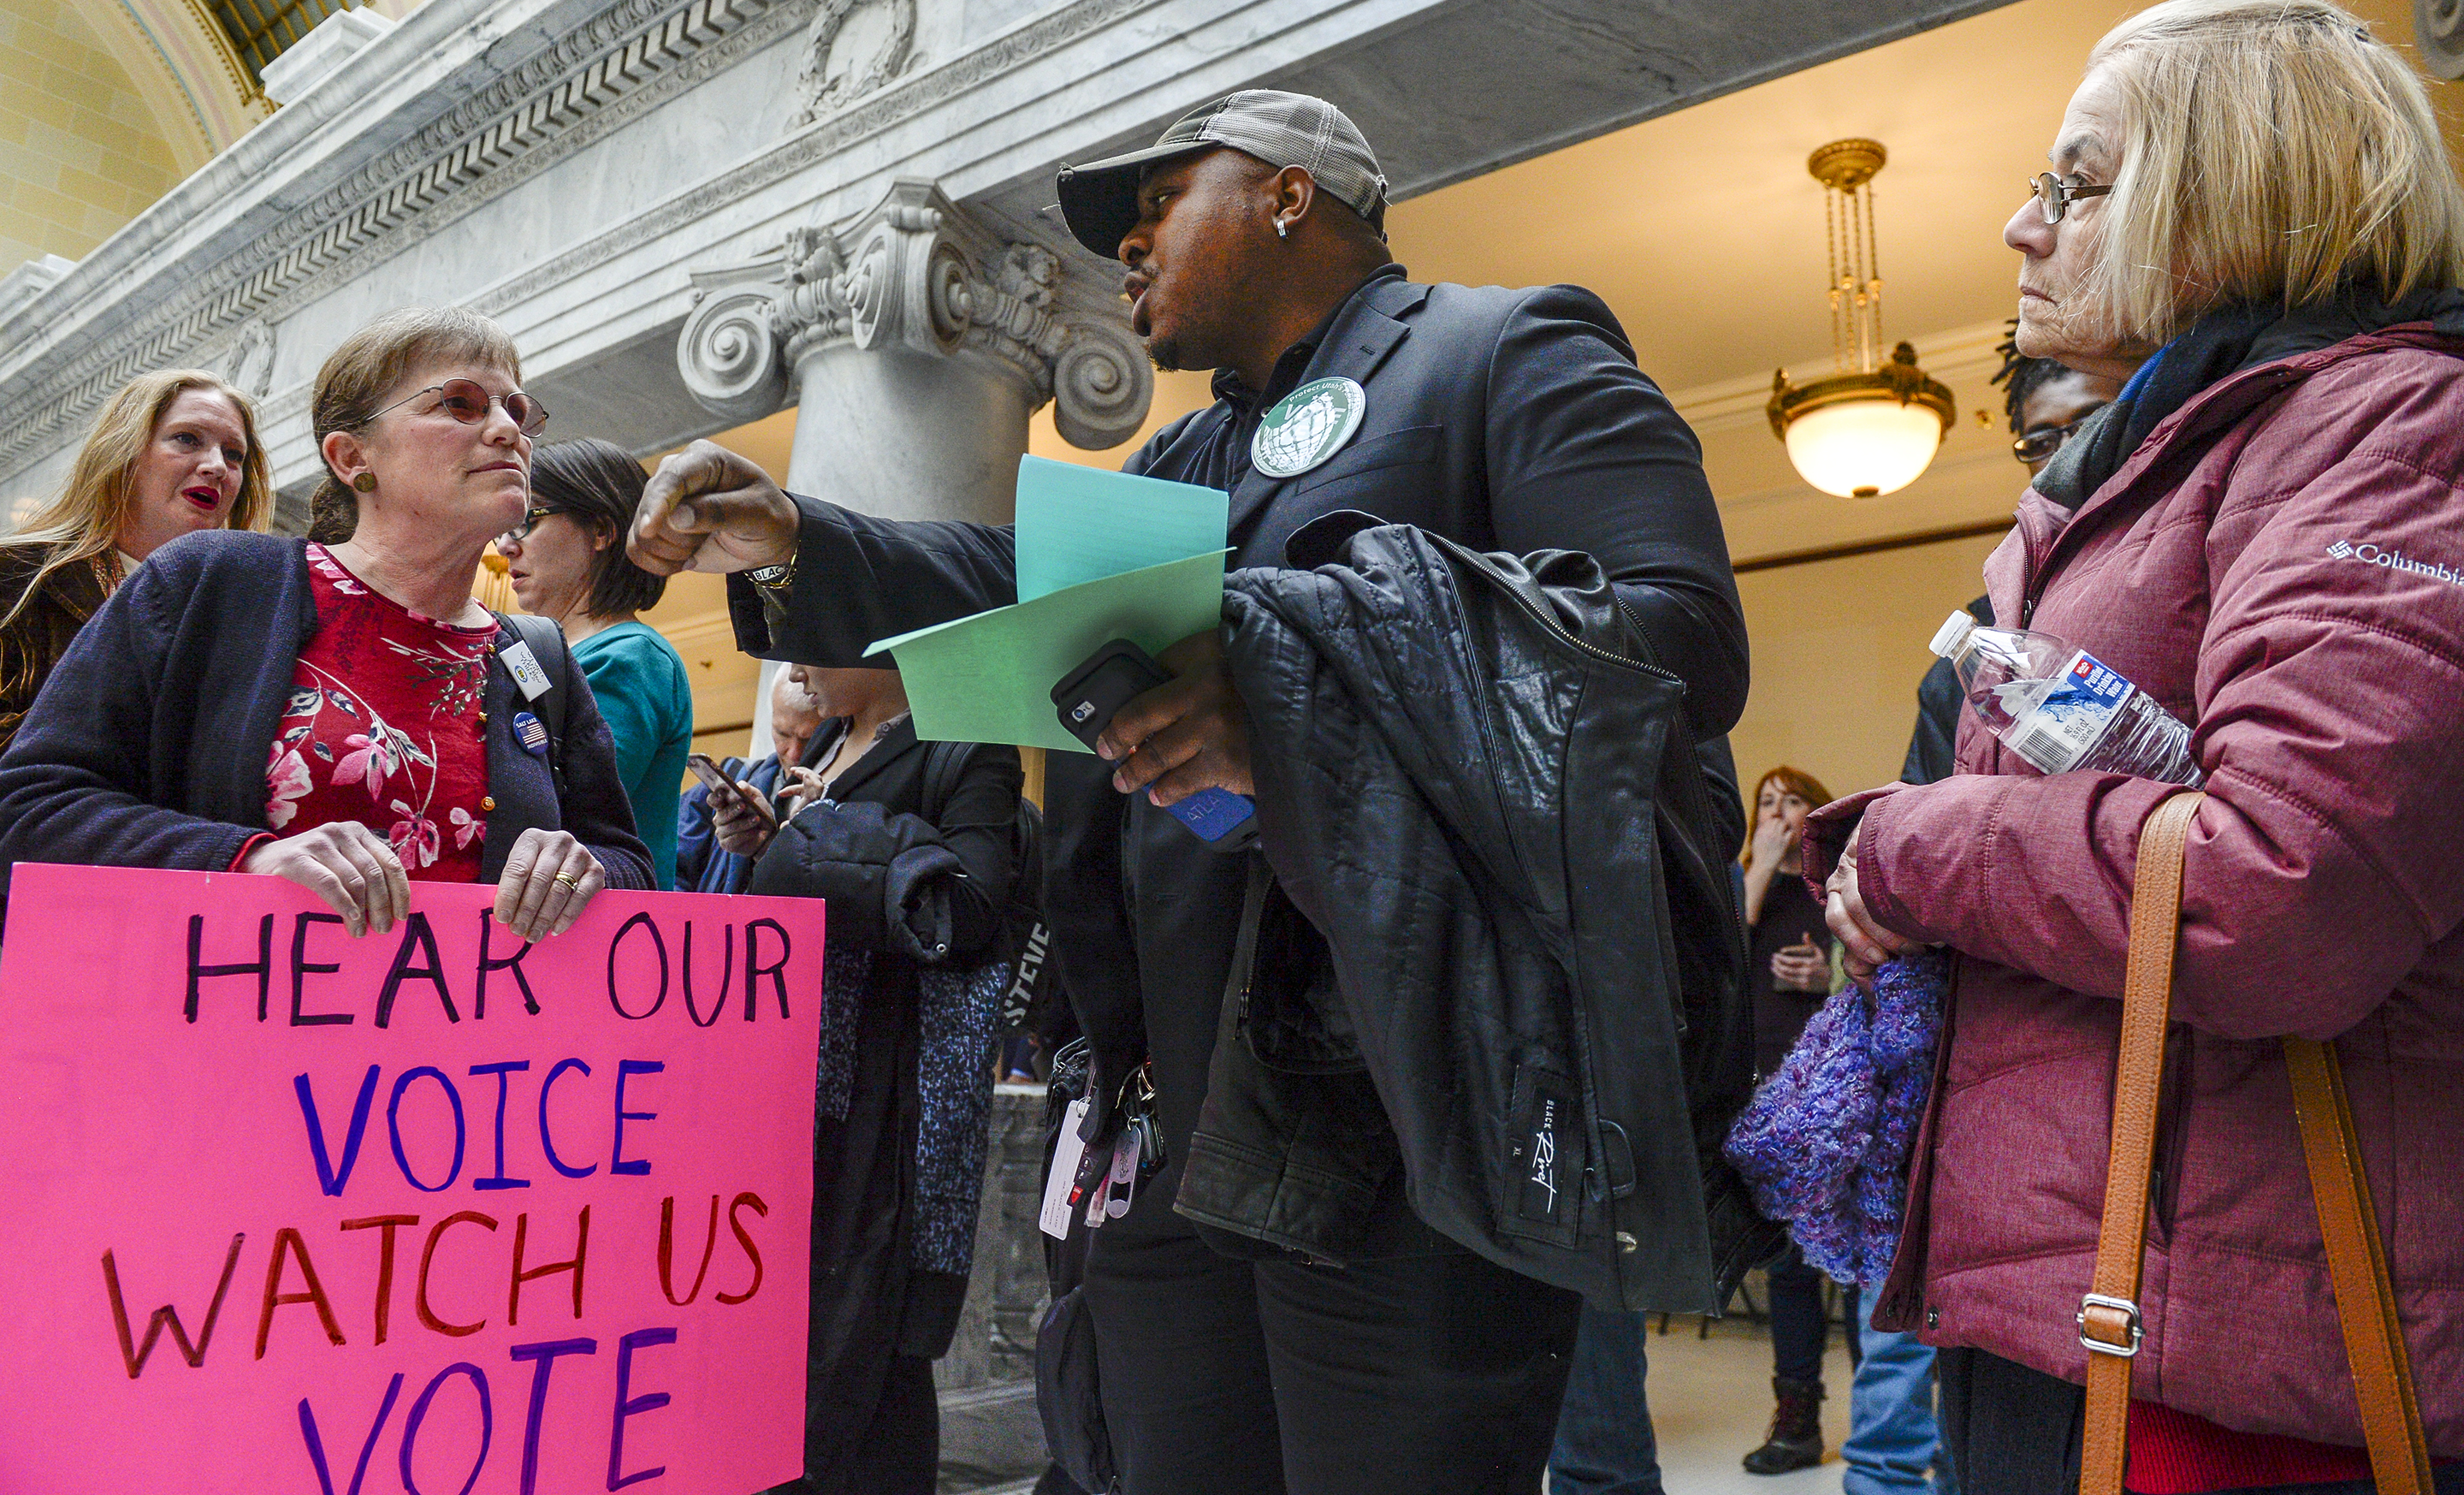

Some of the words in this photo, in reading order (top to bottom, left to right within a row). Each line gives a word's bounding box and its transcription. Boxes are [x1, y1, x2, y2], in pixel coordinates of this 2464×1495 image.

[1289, 384, 1320, 402] Protect
[2083, 665, 2105, 688] Purified
[2093, 672, 2117, 696] Drinking
[2105, 680, 2123, 697] Water
[515, 720, 527, 728] SALT
[2063, 725, 2073, 736] NET
[183, 908, 540, 1029] HEAR
[607, 911, 792, 1027] OUR
[1004, 923, 1050, 1026] STEVE
[293, 1058, 666, 1196] VOICE
[1543, 1100, 1555, 1129] BLACK
[101, 1205, 591, 1379] WATCH
[656, 1192, 768, 1306] US
[298, 1327, 678, 1495] VOTE
